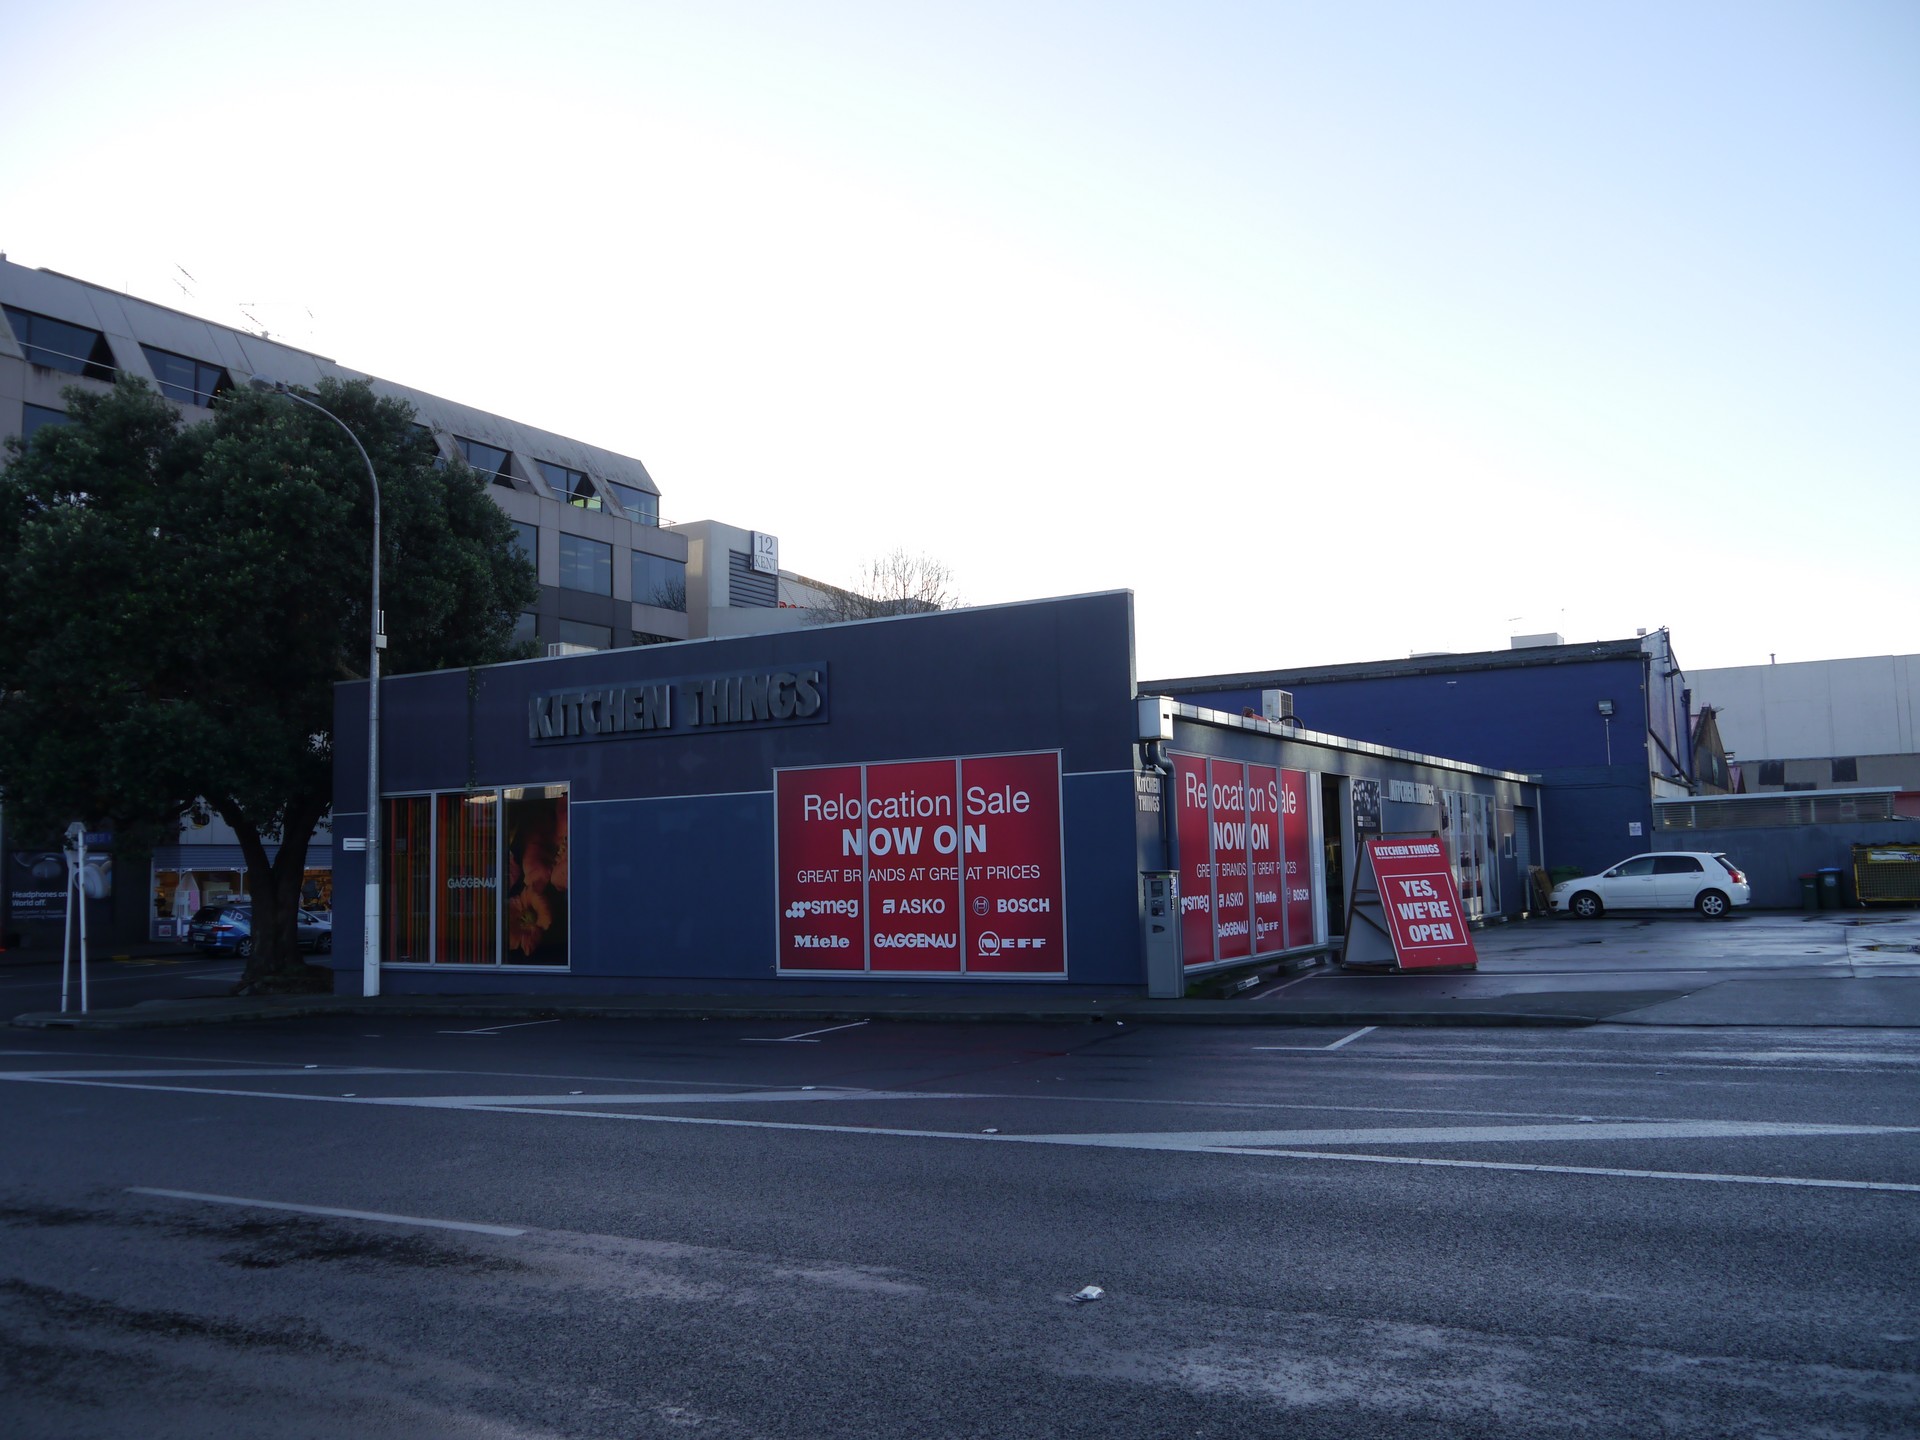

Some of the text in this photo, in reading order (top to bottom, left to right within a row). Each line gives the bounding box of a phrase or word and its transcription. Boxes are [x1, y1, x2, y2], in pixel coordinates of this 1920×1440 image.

[757, 535, 774, 555] 12
[754, 554, 778, 572] KENT
[529, 670, 821, 739] KITCHEN THINGS
[1136, 775, 1161, 794] KITCHEN
[1185, 772, 1266, 813] Reocaton
[1389, 778, 1435, 806] KITCHEN THINGS
[803, 784, 1031, 822] Relocation Sale
[1138, 794, 1161, 813] THINGS
[842, 824, 987, 857] NOW ON
[1213, 821, 1270, 851] NOW ON
[1373, 845, 1410, 857] KITCHEN
[1407, 843, 1441, 855] THINGS
[797, 864, 1041, 884] GREAT BRANDS AT GREAT PRICES
[1196, 863, 1220, 878] GRET
[1221, 862, 1247, 877] BRANDS
[1257, 861, 1275, 876] GREAT
[447, 877, 498, 889] GAGGENAU
[1398, 879, 1439, 900] YES,
[12, 891, 57, 899] Headphones
[12, 899, 47, 907] World off.
[1187, 894, 1210, 914] smeg
[1225, 892, 1244, 908] ASKO
[1255, 890, 1277, 905] Miele
[1292, 888, 1310, 902] BOSCH
[811, 899, 859, 918] smeg
[899, 898, 945, 914] ASKO
[996, 897, 1051, 913] BOSCH
[1396, 901, 1453, 921] WE'RE
[793, 934, 851, 949] Miele
[873, 932, 958, 949] GAGGENAU
[1408, 922, 1455, 943] OPEN
[979, 934, 1048, 952] NEFF
